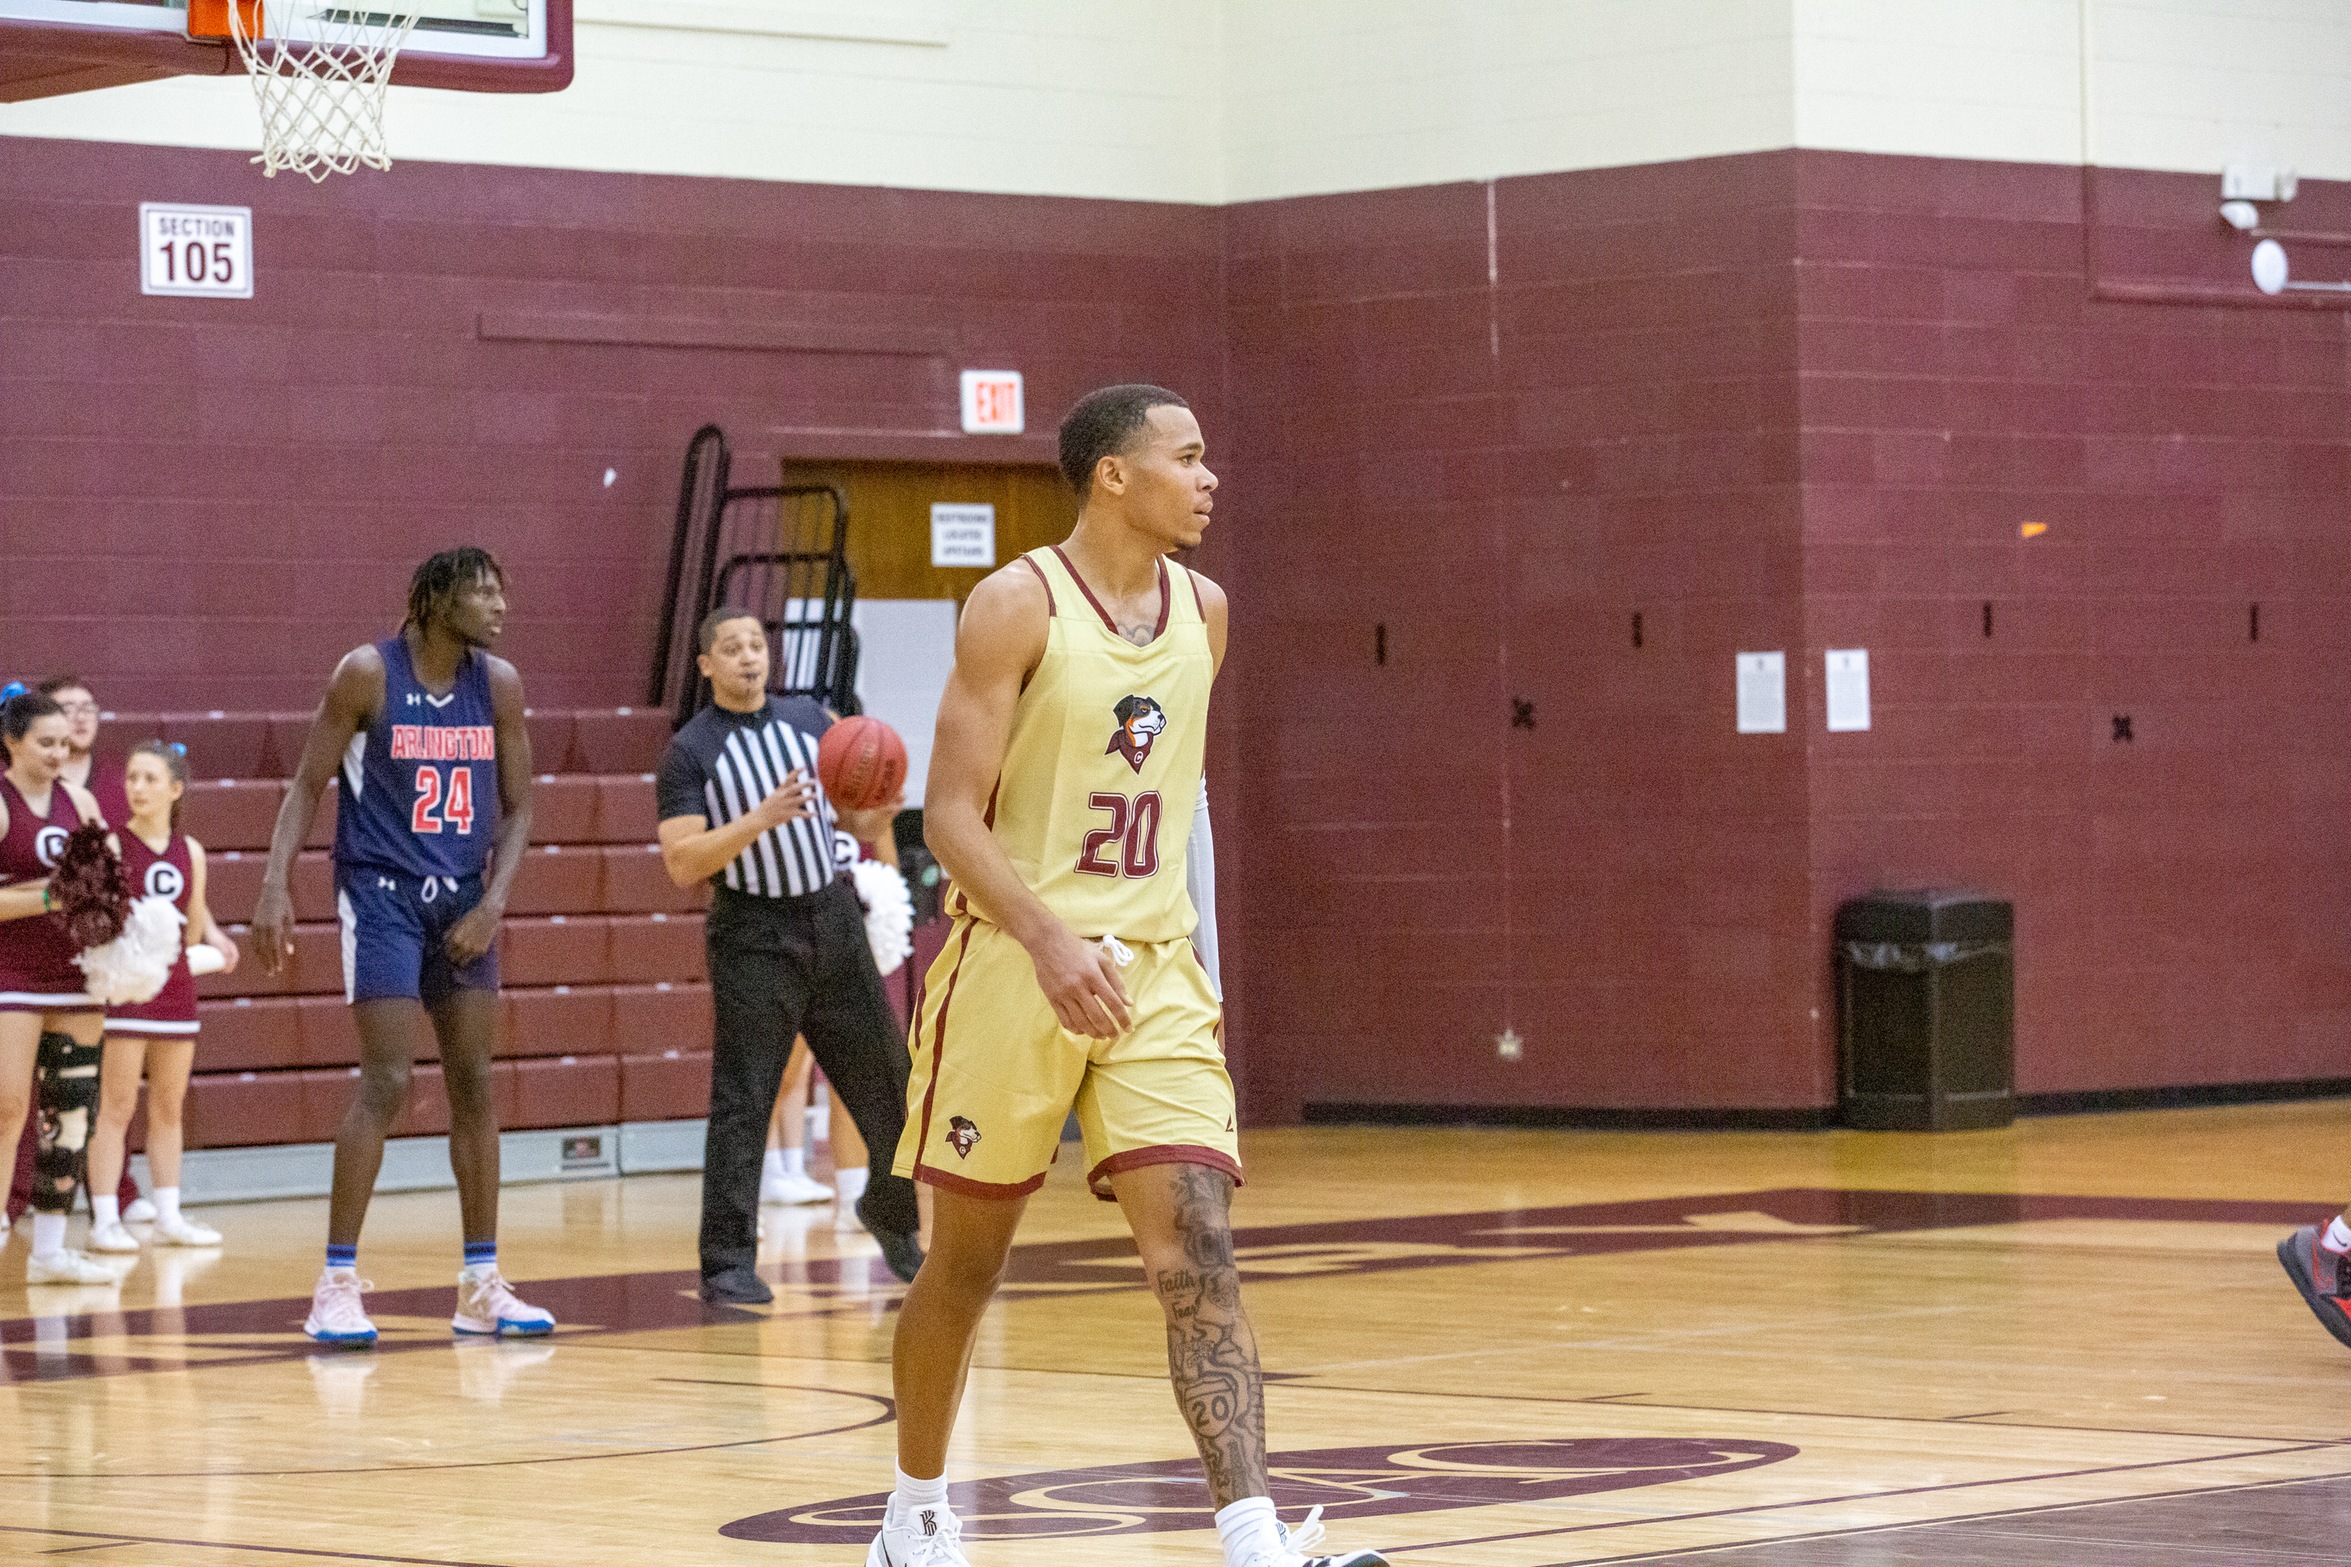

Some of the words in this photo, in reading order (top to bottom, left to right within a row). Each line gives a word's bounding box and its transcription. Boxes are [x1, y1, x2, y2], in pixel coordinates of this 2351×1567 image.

[160, 217, 235, 237] SECTION
[160, 241, 233, 283] 105
[976, 382, 1016, 422] EXIT
[391, 725, 496, 760] ARLINGTON
[1134, 751, 1144, 764] C
[412, 765, 475, 834] 24
[1074, 790, 1163, 879] 20
[153, 870, 176, 895] C
[1157, 1269, 1196, 1295] Faith
[1192, 1395, 1229, 1427] 20
